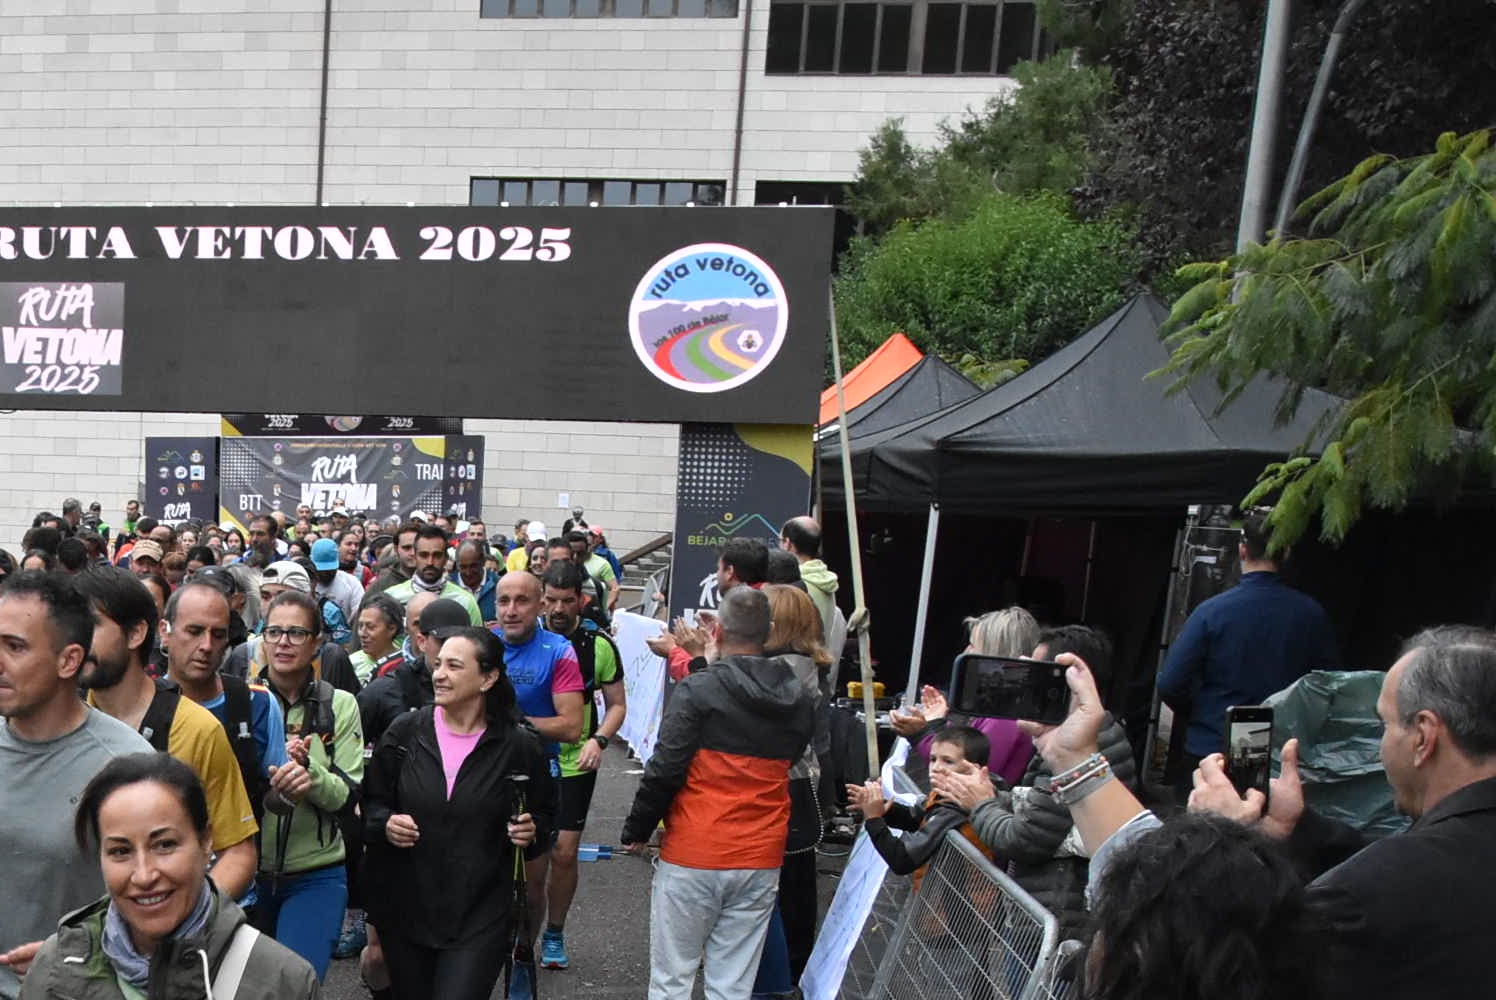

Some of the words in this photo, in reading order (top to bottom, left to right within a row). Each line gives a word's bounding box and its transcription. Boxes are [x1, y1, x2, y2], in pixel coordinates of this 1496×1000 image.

[156, 226, 400, 261] VETONA
[418, 226, 572, 262] 2025
[650, 264, 691, 300] ruta
[695, 255, 771, 298] vetona
[18, 283, 95, 328] RUTA
[2, 327, 124, 367] VETONA
[15, 365, 101, 396] 2025
[311, 453, 358, 483] RUTA
[415, 463, 444, 481] TRAI
[163, 501, 191, 520] RUTA
[239, 494, 264, 511] BTT
[301, 483, 378, 510] VETONA
